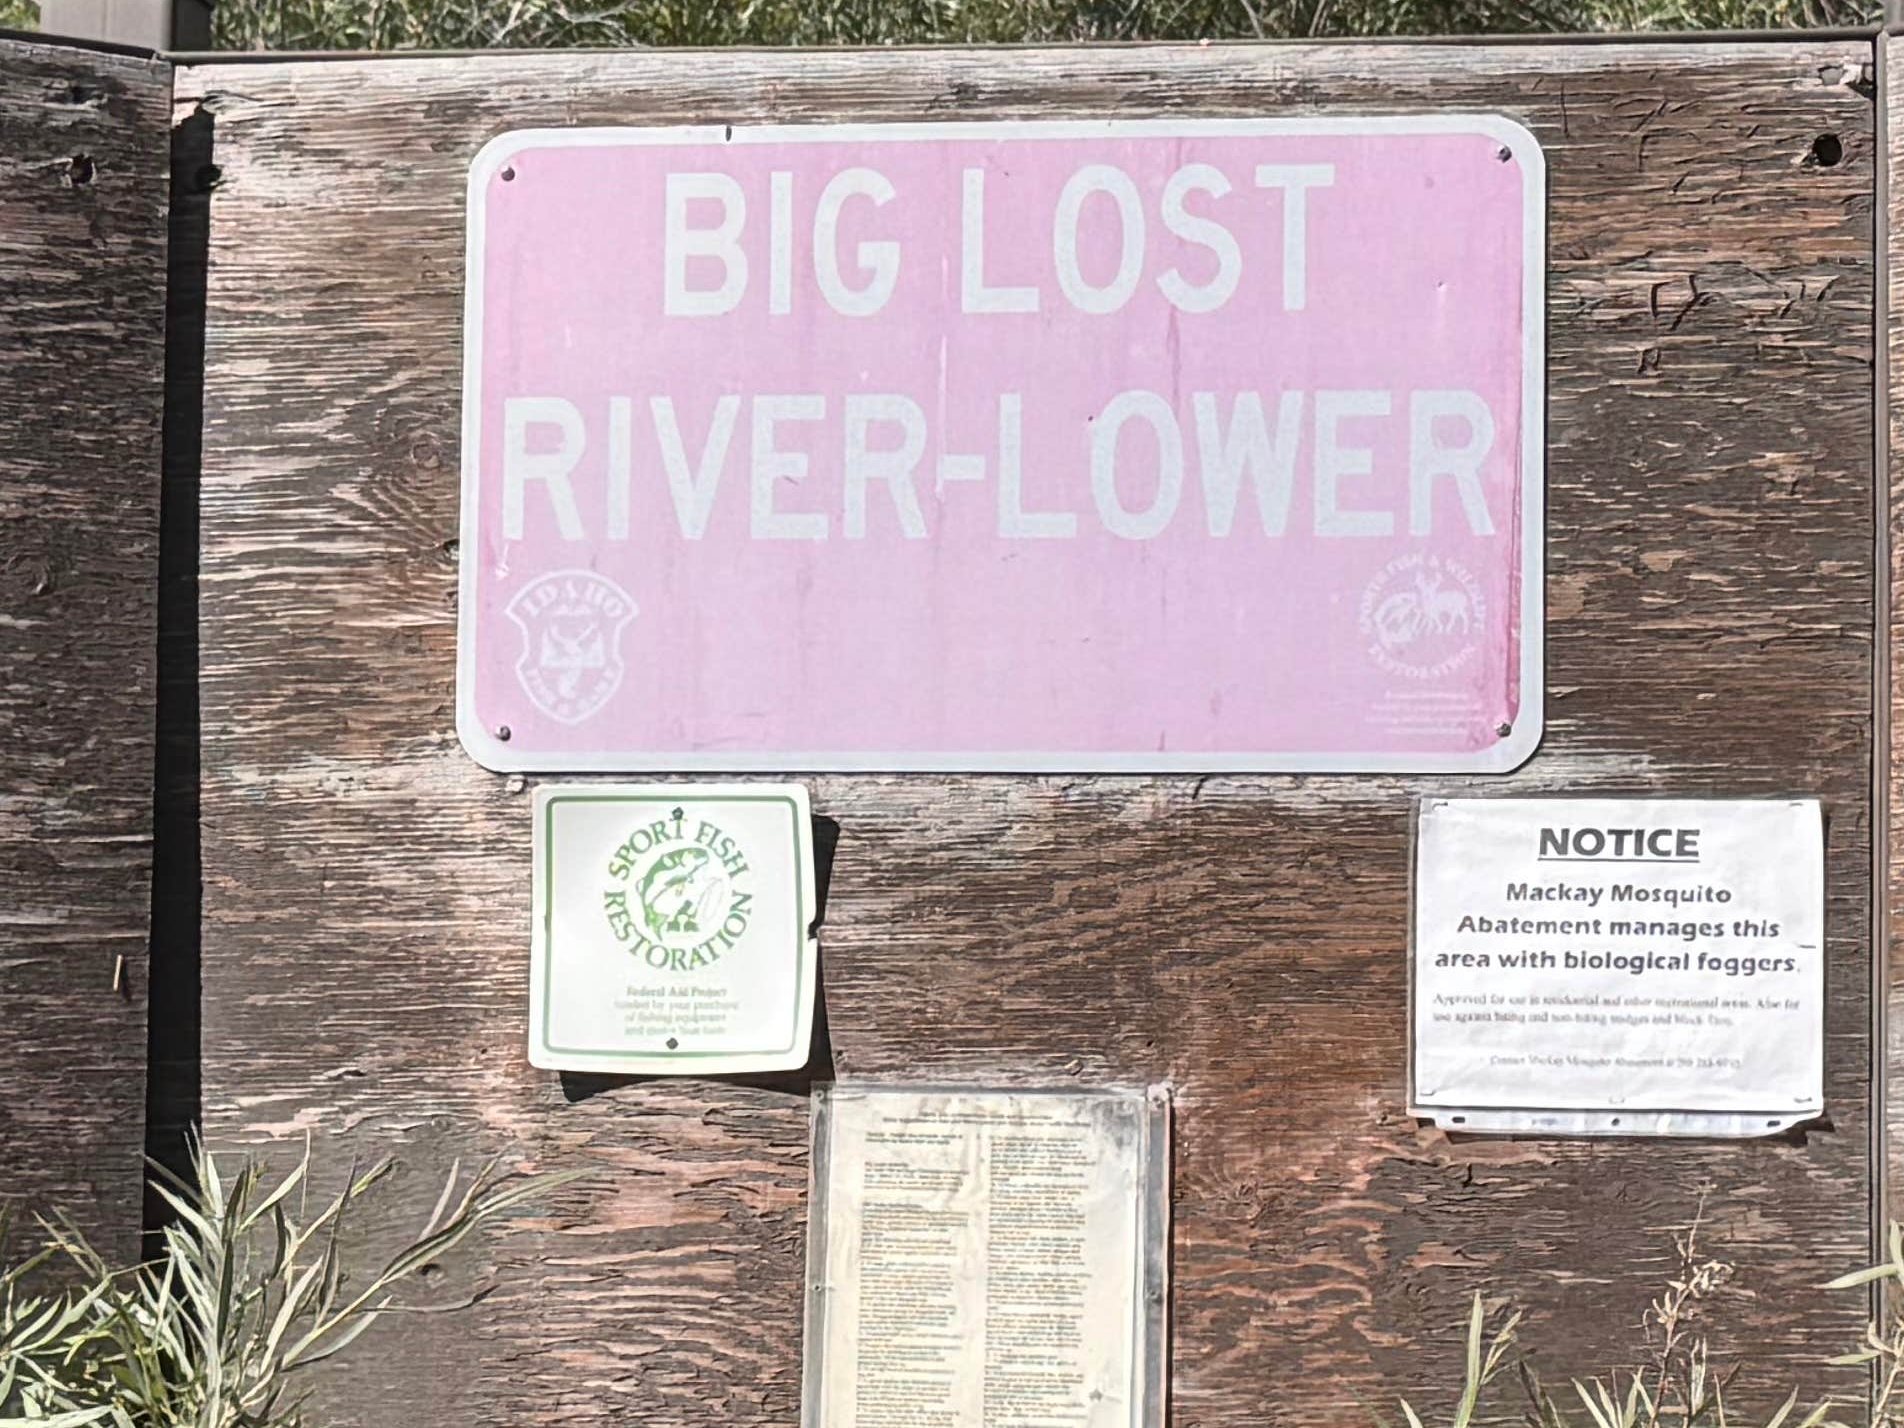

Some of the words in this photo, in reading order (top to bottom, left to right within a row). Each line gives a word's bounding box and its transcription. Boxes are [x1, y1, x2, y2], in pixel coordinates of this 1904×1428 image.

[663, 167, 901, 316] BIG
[961, 163, 1335, 315] LOST
[502, 388, 1496, 541] RIVER-LOWER
[608, 817, 687, 882] SPORT
[695, 821, 750, 878] FISH
[1538, 828, 1701, 858] NOTICE
[1506, 882, 1604, 906] Mackay
[1611, 883, 1732, 908] Mosquito
[604, 890, 753, 971] RESTORATION
[1457, 915, 1602, 935] Abatement
[1609, 920, 1725, 941] manages
[1733, 919, 1780, 938] this
[1434, 953, 1491, 969] area
[1497, 950, 1556, 970] with
[1564, 951, 1690, 975] biological
[1697, 953, 1801, 976] foggers.
